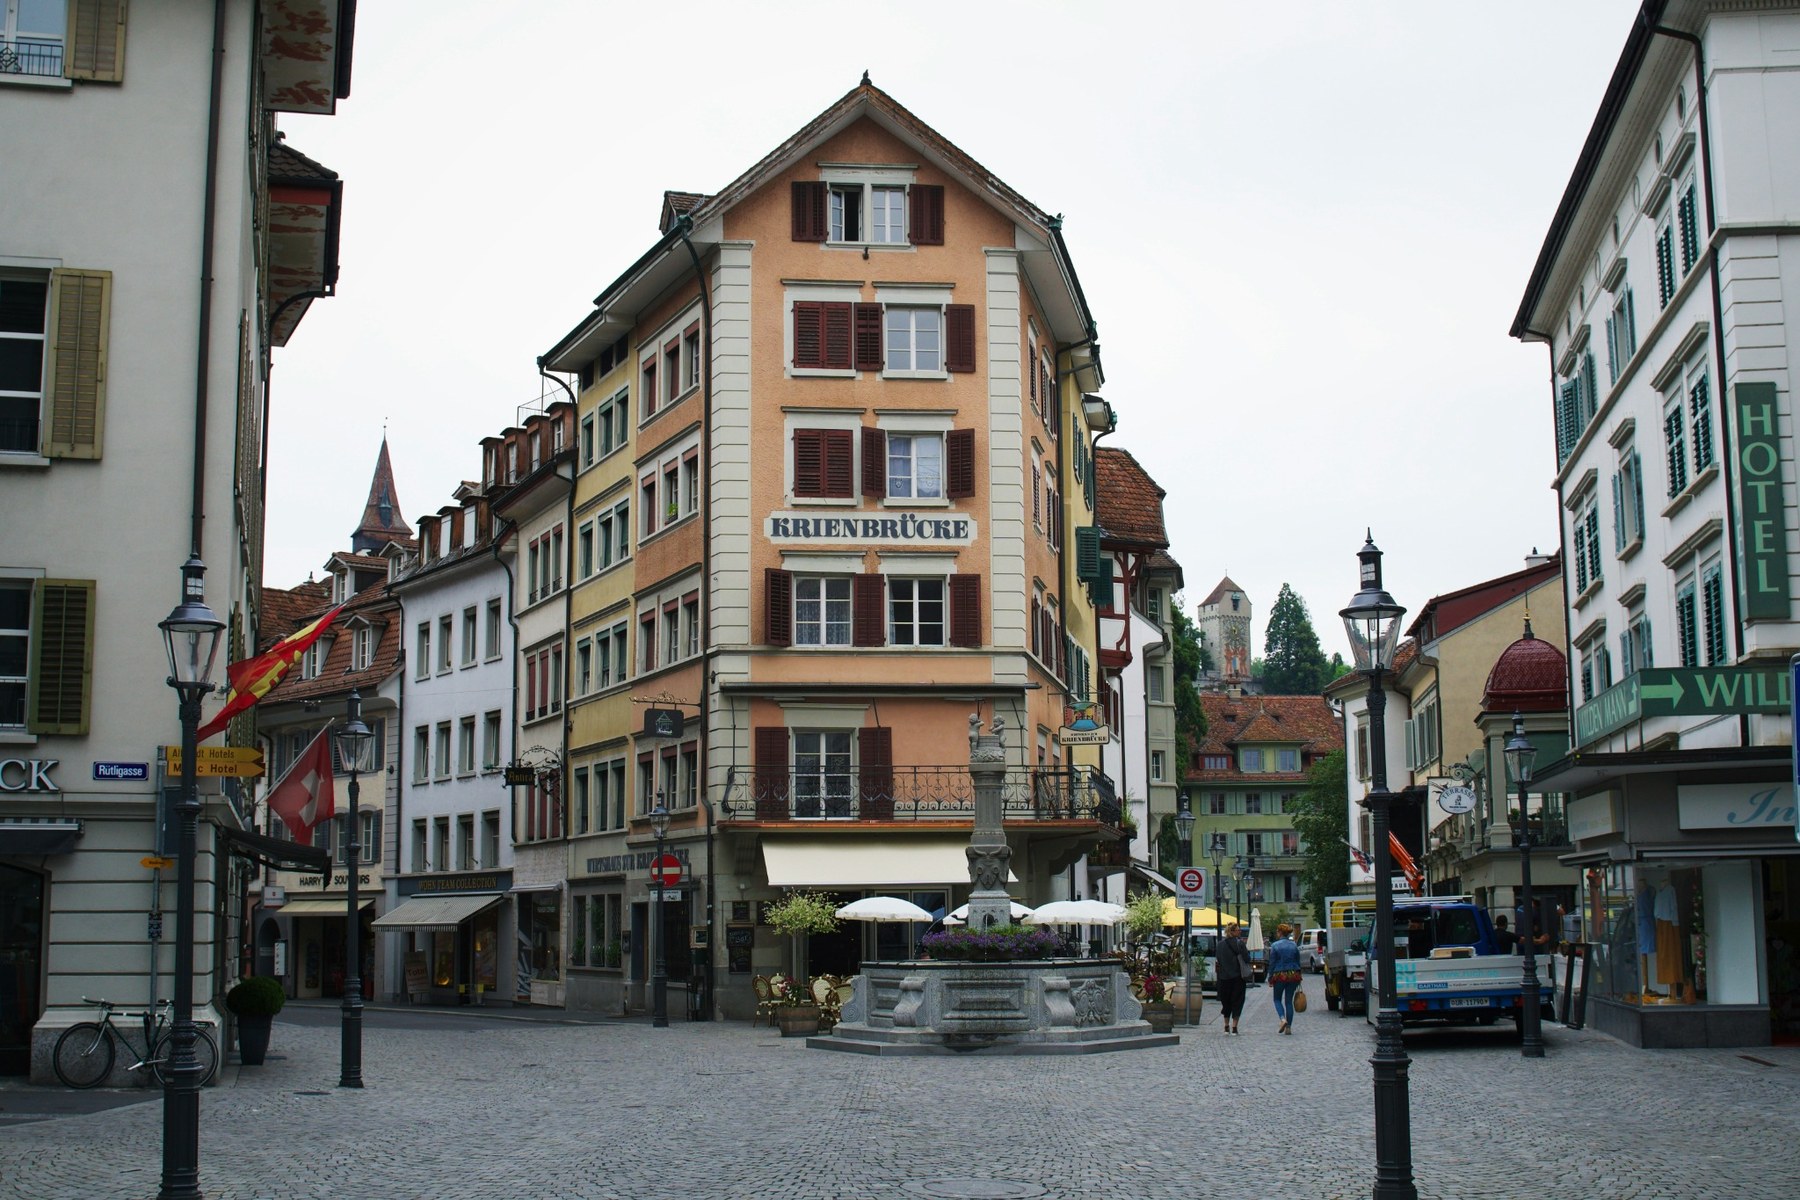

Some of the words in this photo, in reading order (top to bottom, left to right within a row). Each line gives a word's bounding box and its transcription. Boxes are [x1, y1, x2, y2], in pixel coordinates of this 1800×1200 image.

[1741, 403, 1780, 593] HOTEL
[770, 513, 969, 539] KRIENBRÜCKE
[1604, 685, 1628, 728] MANN
[209, 749, 235, 759] Hotels
[98, 764, 143, 778] Rütligasse
[210, 764, 237, 773] Hotel
[1442, 787, 1475, 801] TERRASSE
